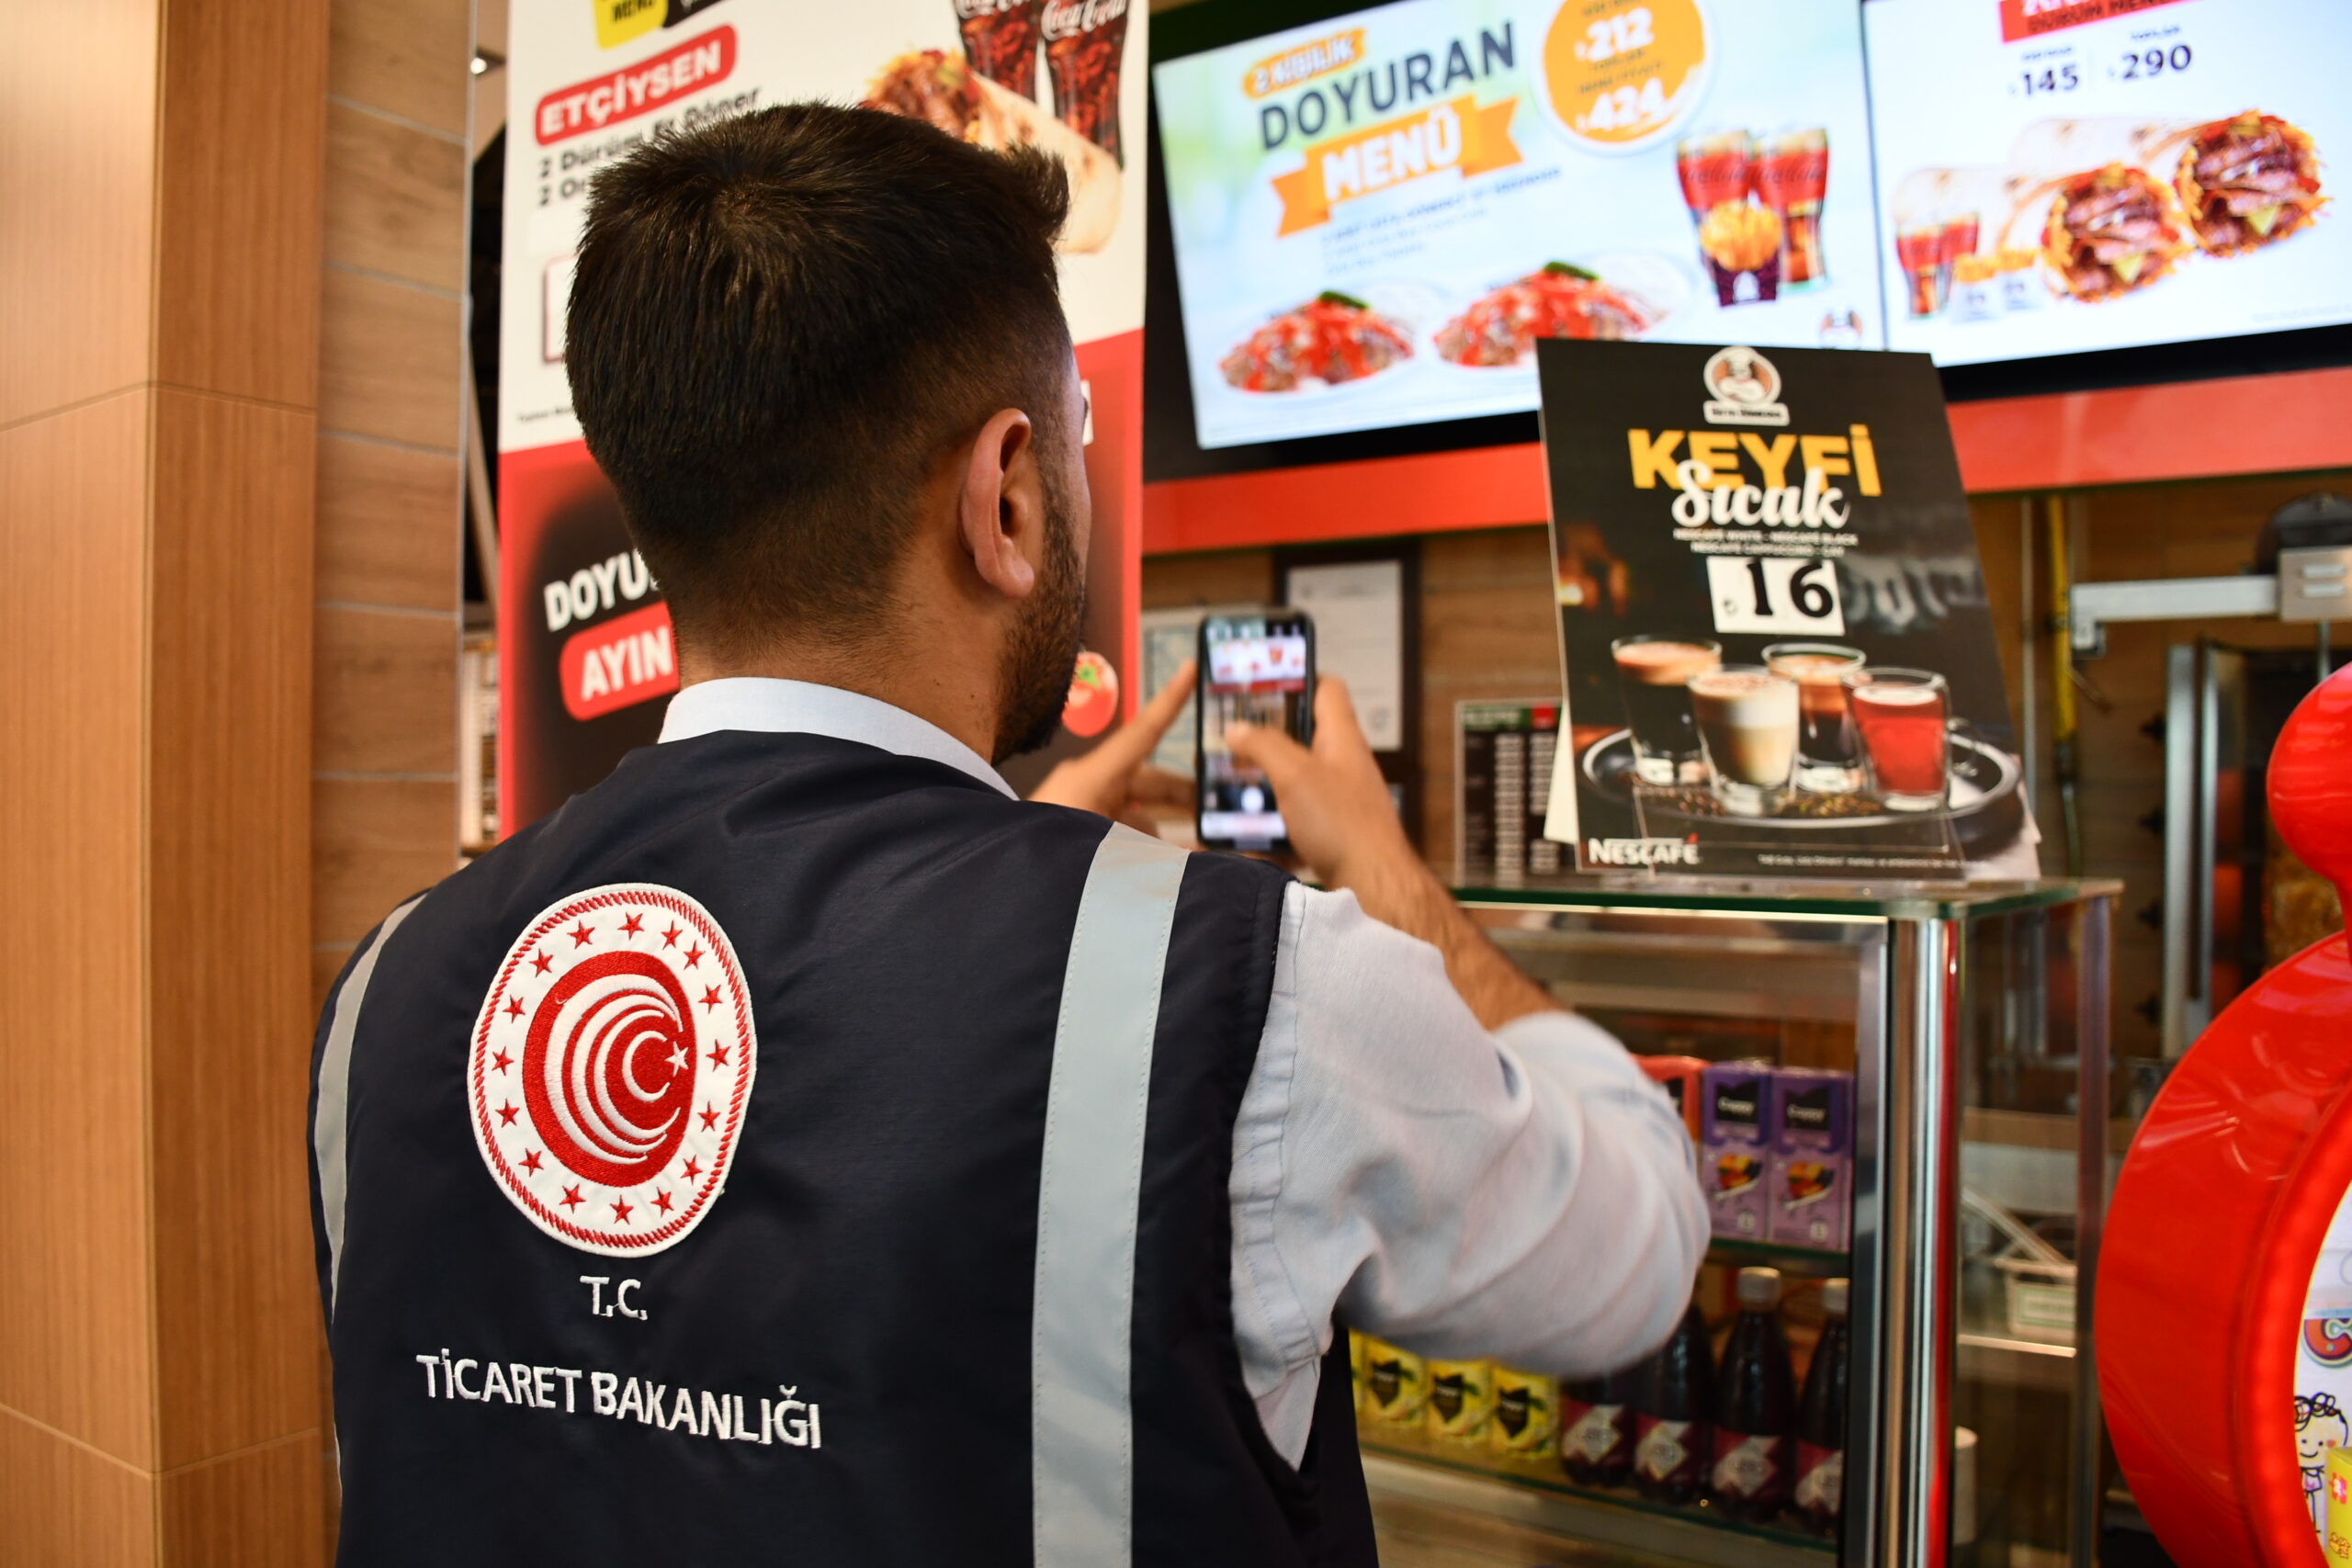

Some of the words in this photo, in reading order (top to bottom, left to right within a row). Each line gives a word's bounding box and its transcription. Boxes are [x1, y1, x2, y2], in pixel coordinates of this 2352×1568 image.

[540, 39, 722, 137] ETÇİYSEN
[1261, 21, 1514, 151] DOYURAN
[1322, 103, 1463, 201] MENÜ
[1627, 423, 1882, 497] KEYFİ
[1671, 459, 1850, 529] Sıcak
[544, 549, 658, 632] DOYU
[581, 626, 674, 701] AYIN
[1589, 832, 1701, 864] NESCAFÉ
[580, 1275, 648, 1320] T.C.
[416, 1348, 582, 1413] TİCARET
[591, 1371, 821, 1449] BAKANLIĞI
